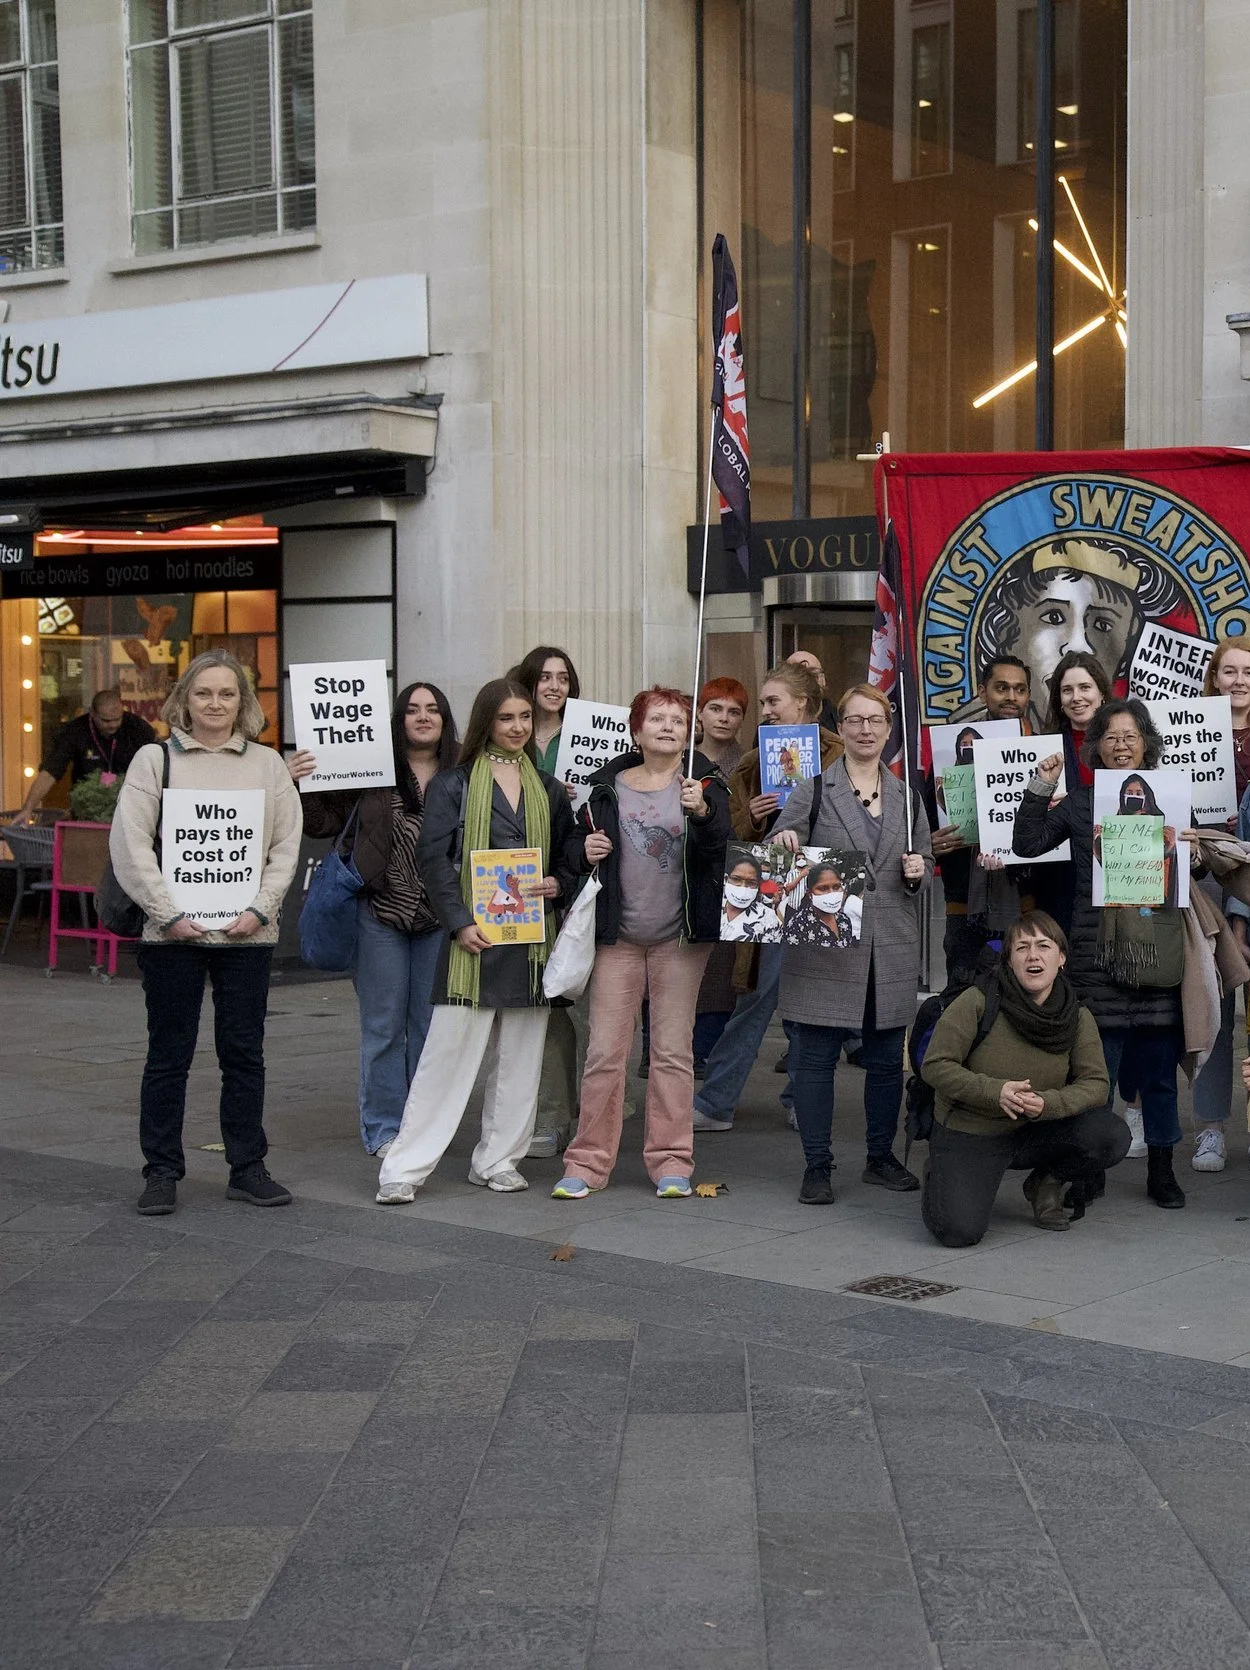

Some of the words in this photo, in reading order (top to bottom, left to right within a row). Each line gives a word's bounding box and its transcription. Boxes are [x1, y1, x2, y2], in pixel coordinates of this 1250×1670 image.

[0, 335, 60, 389] tsu
[718, 434, 748, 483] LOBAL
[20, 567, 45, 585] rice
[48, 564, 89, 584] bowls
[106, 564, 149, 588] gyoza
[166, 557, 190, 580] hot
[194, 556, 254, 578] noodles
[926, 522, 1003, 718] AGAINST
[1138, 648, 1205, 682] NATIONA
[314, 676, 365, 697] Stop
[1133, 667, 1205, 698] WORKER
[310, 702, 372, 722] Wage
[1168, 710, 1205, 725] Who
[591, 715, 627, 733] Who
[313, 724, 374, 745] Theft
[570, 734, 609, 751] pays
[614, 738, 638, 753] the
[1163, 733, 1192, 748] ays
[1196, 728, 1222, 743] the
[765, 736, 814, 752] PEOPLE
[1001, 749, 1037, 764] Who
[1161, 750, 1196, 765] cost
[1200, 747, 1217, 762] of
[311, 770, 383, 781] #PayYourWorkers
[986, 770, 1024, 788] pays
[1190, 767, 1225, 782] ion?
[994, 790, 1024, 803] cos
[195, 804, 237, 819] Who
[175, 828, 220, 844] pays
[226, 825, 253, 840] the
[1132, 823, 1154, 837] ME
[182, 848, 224, 862] cost
[229, 846, 247, 861] of
[174, 867, 253, 883] fashion?
[182, 911, 243, 920] ayYourWork
